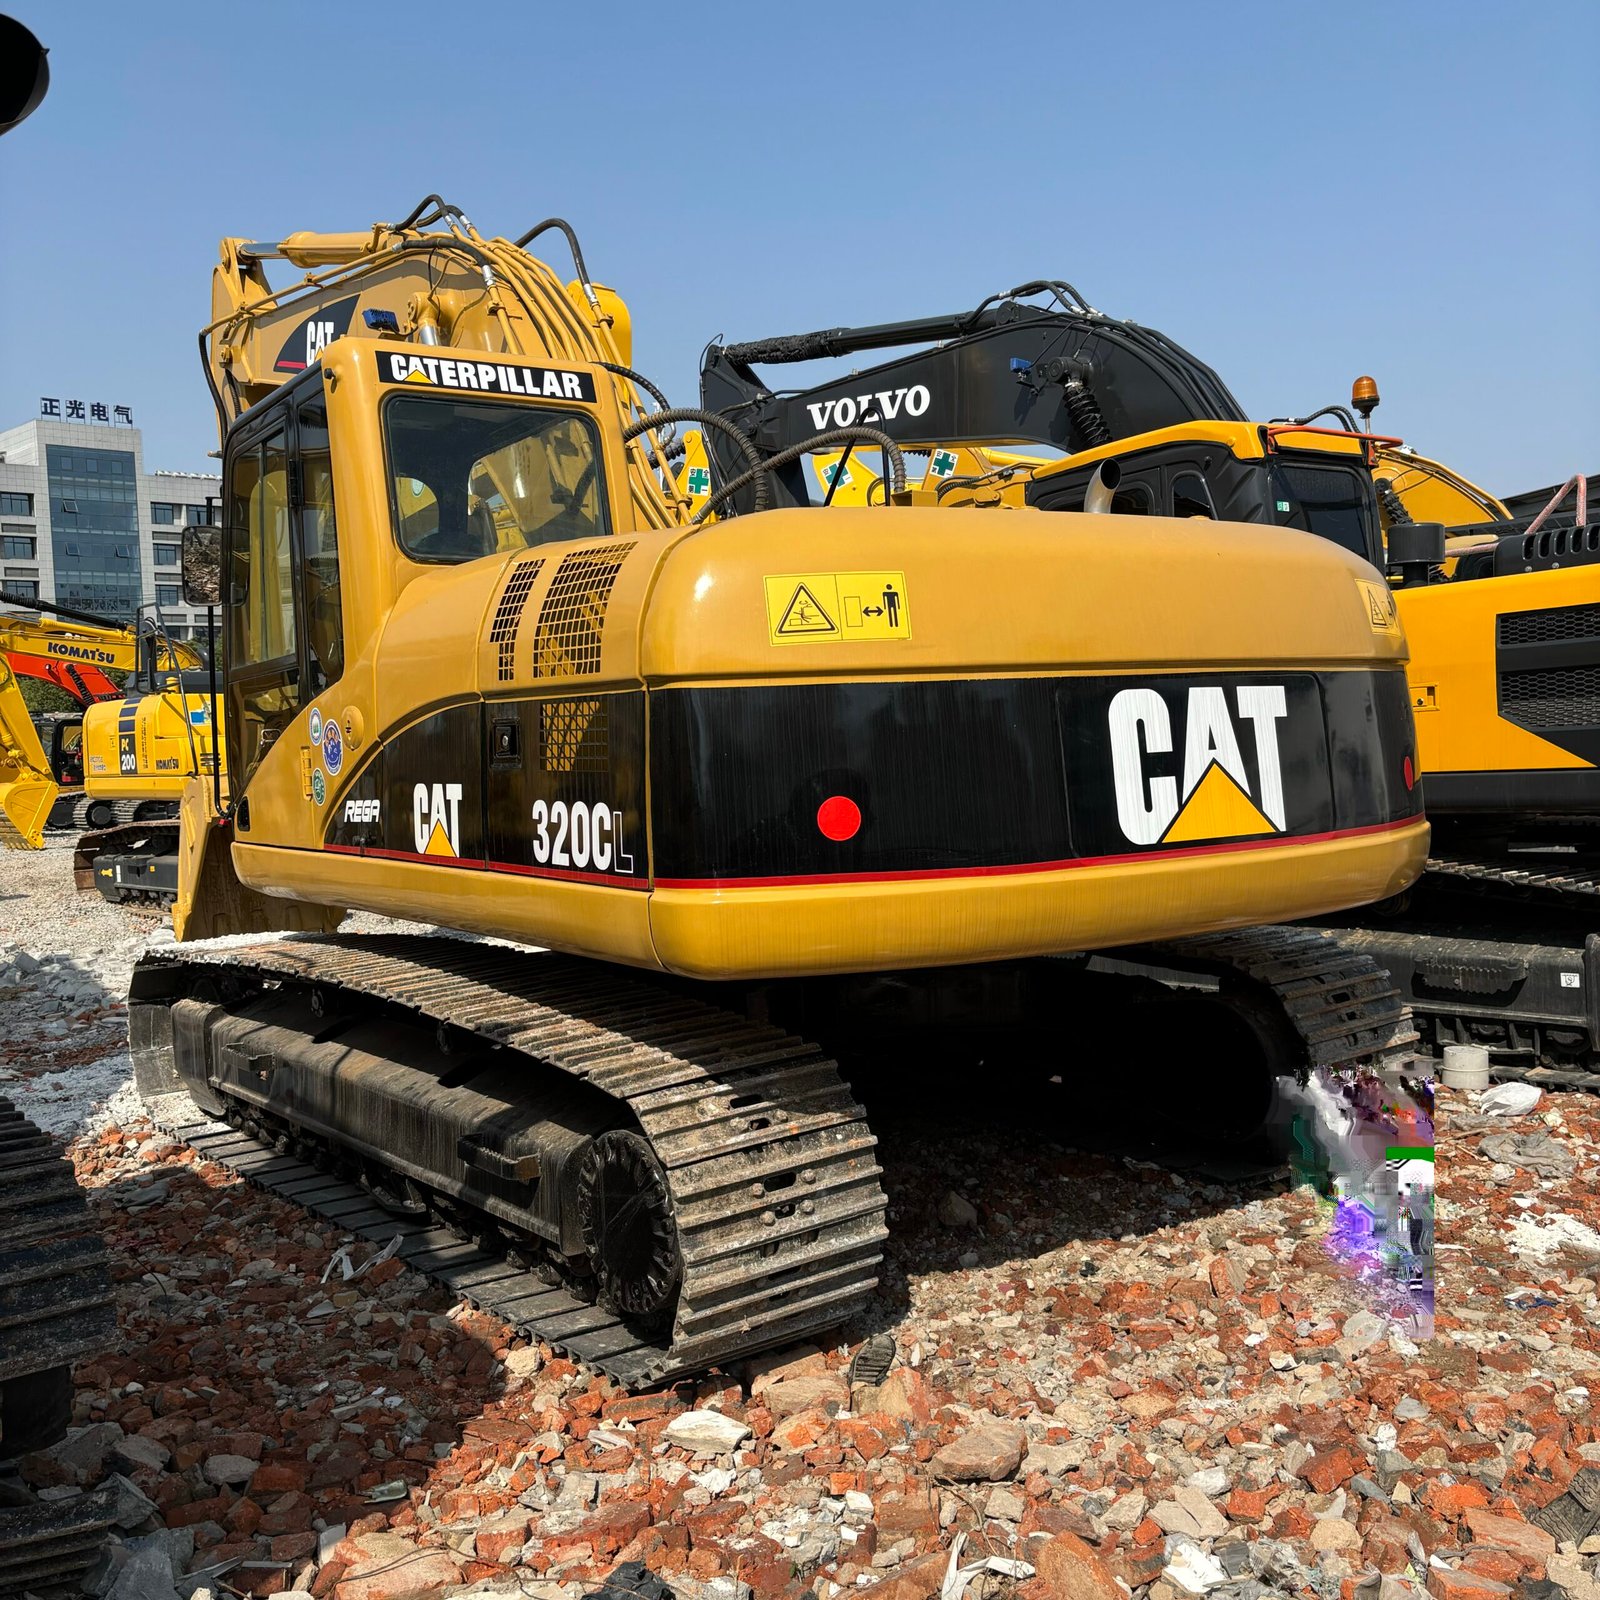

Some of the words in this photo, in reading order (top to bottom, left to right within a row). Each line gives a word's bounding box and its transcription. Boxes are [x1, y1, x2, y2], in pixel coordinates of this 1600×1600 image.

[389, 353, 584, 400] CATERPILLAR
[41, 397, 133, 425] 正光电气
[806, 384, 931, 430] VOLVO
[47, 641, 115, 664] KOMATSU
[121, 738, 129, 752] PC
[121, 753, 136, 771] 200
[1107, 684, 1288, 846] CAT
[343, 799, 381, 823] REGA
[413, 783, 463, 858] CAT
